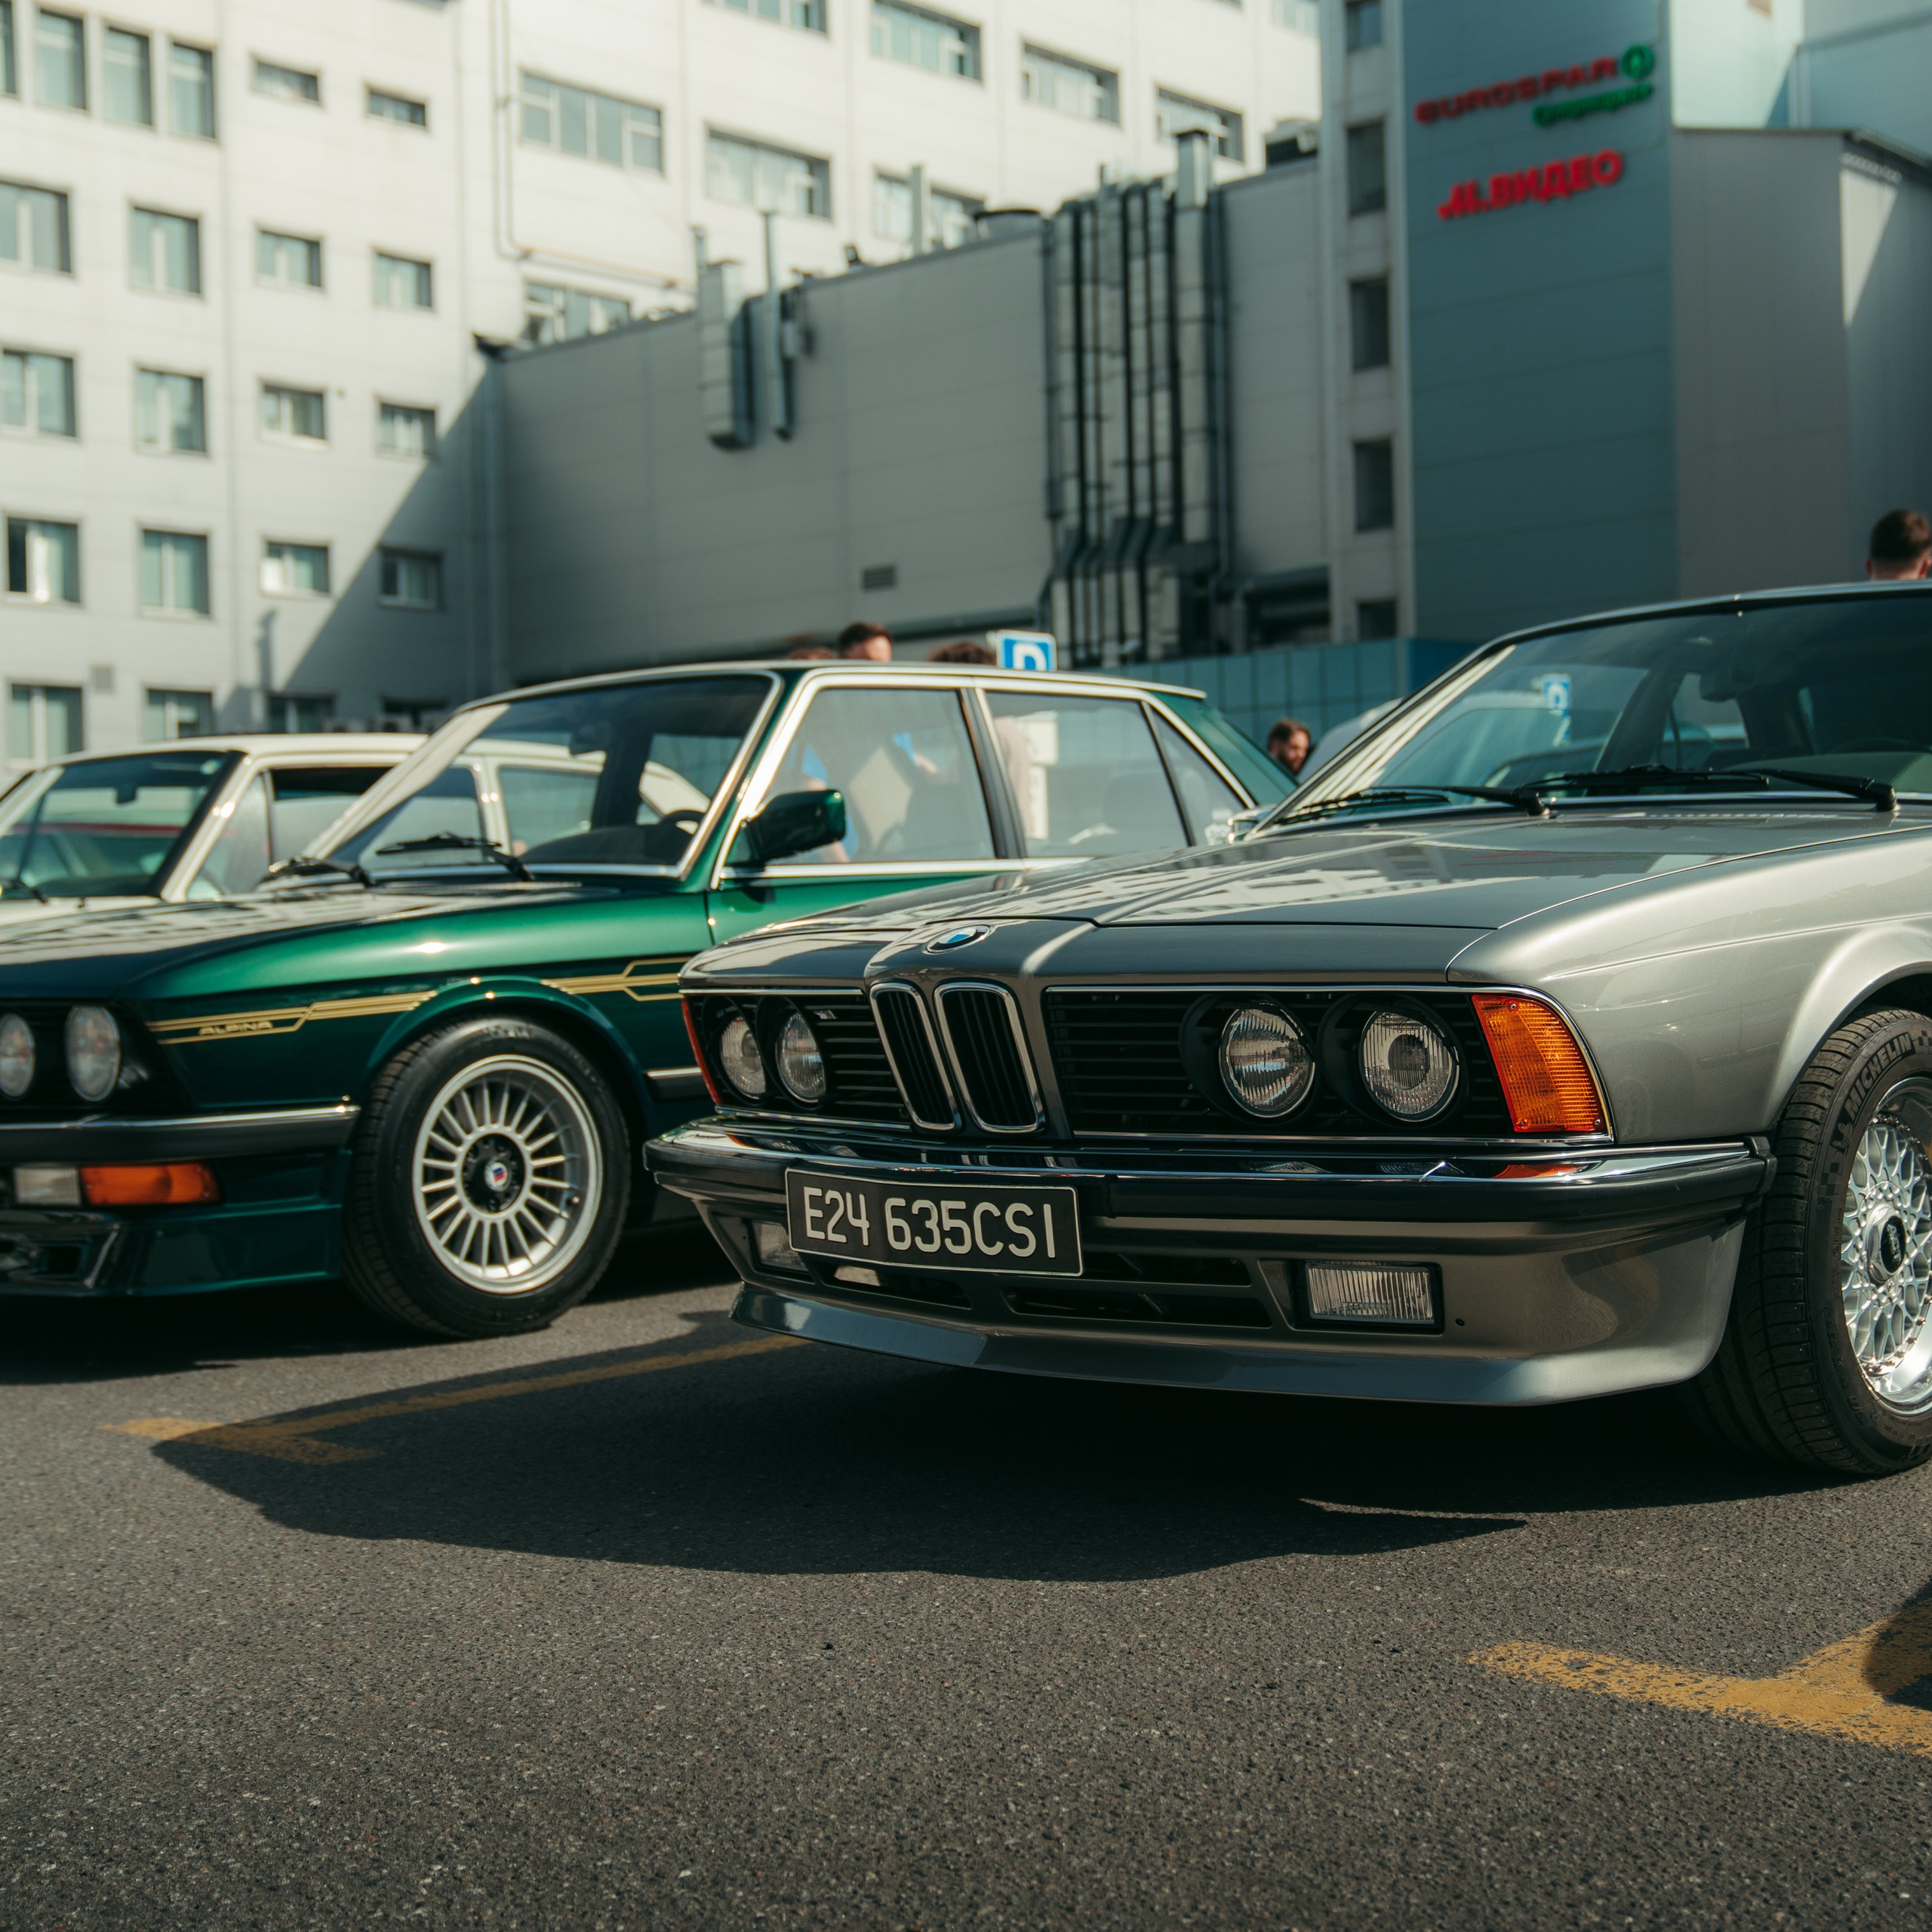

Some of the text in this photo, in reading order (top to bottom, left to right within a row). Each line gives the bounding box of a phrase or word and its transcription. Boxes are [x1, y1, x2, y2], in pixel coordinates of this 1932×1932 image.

[1844, 1033, 1912, 1121] MICHELIN
[803, 1186, 1056, 1259] E24 635CSI
